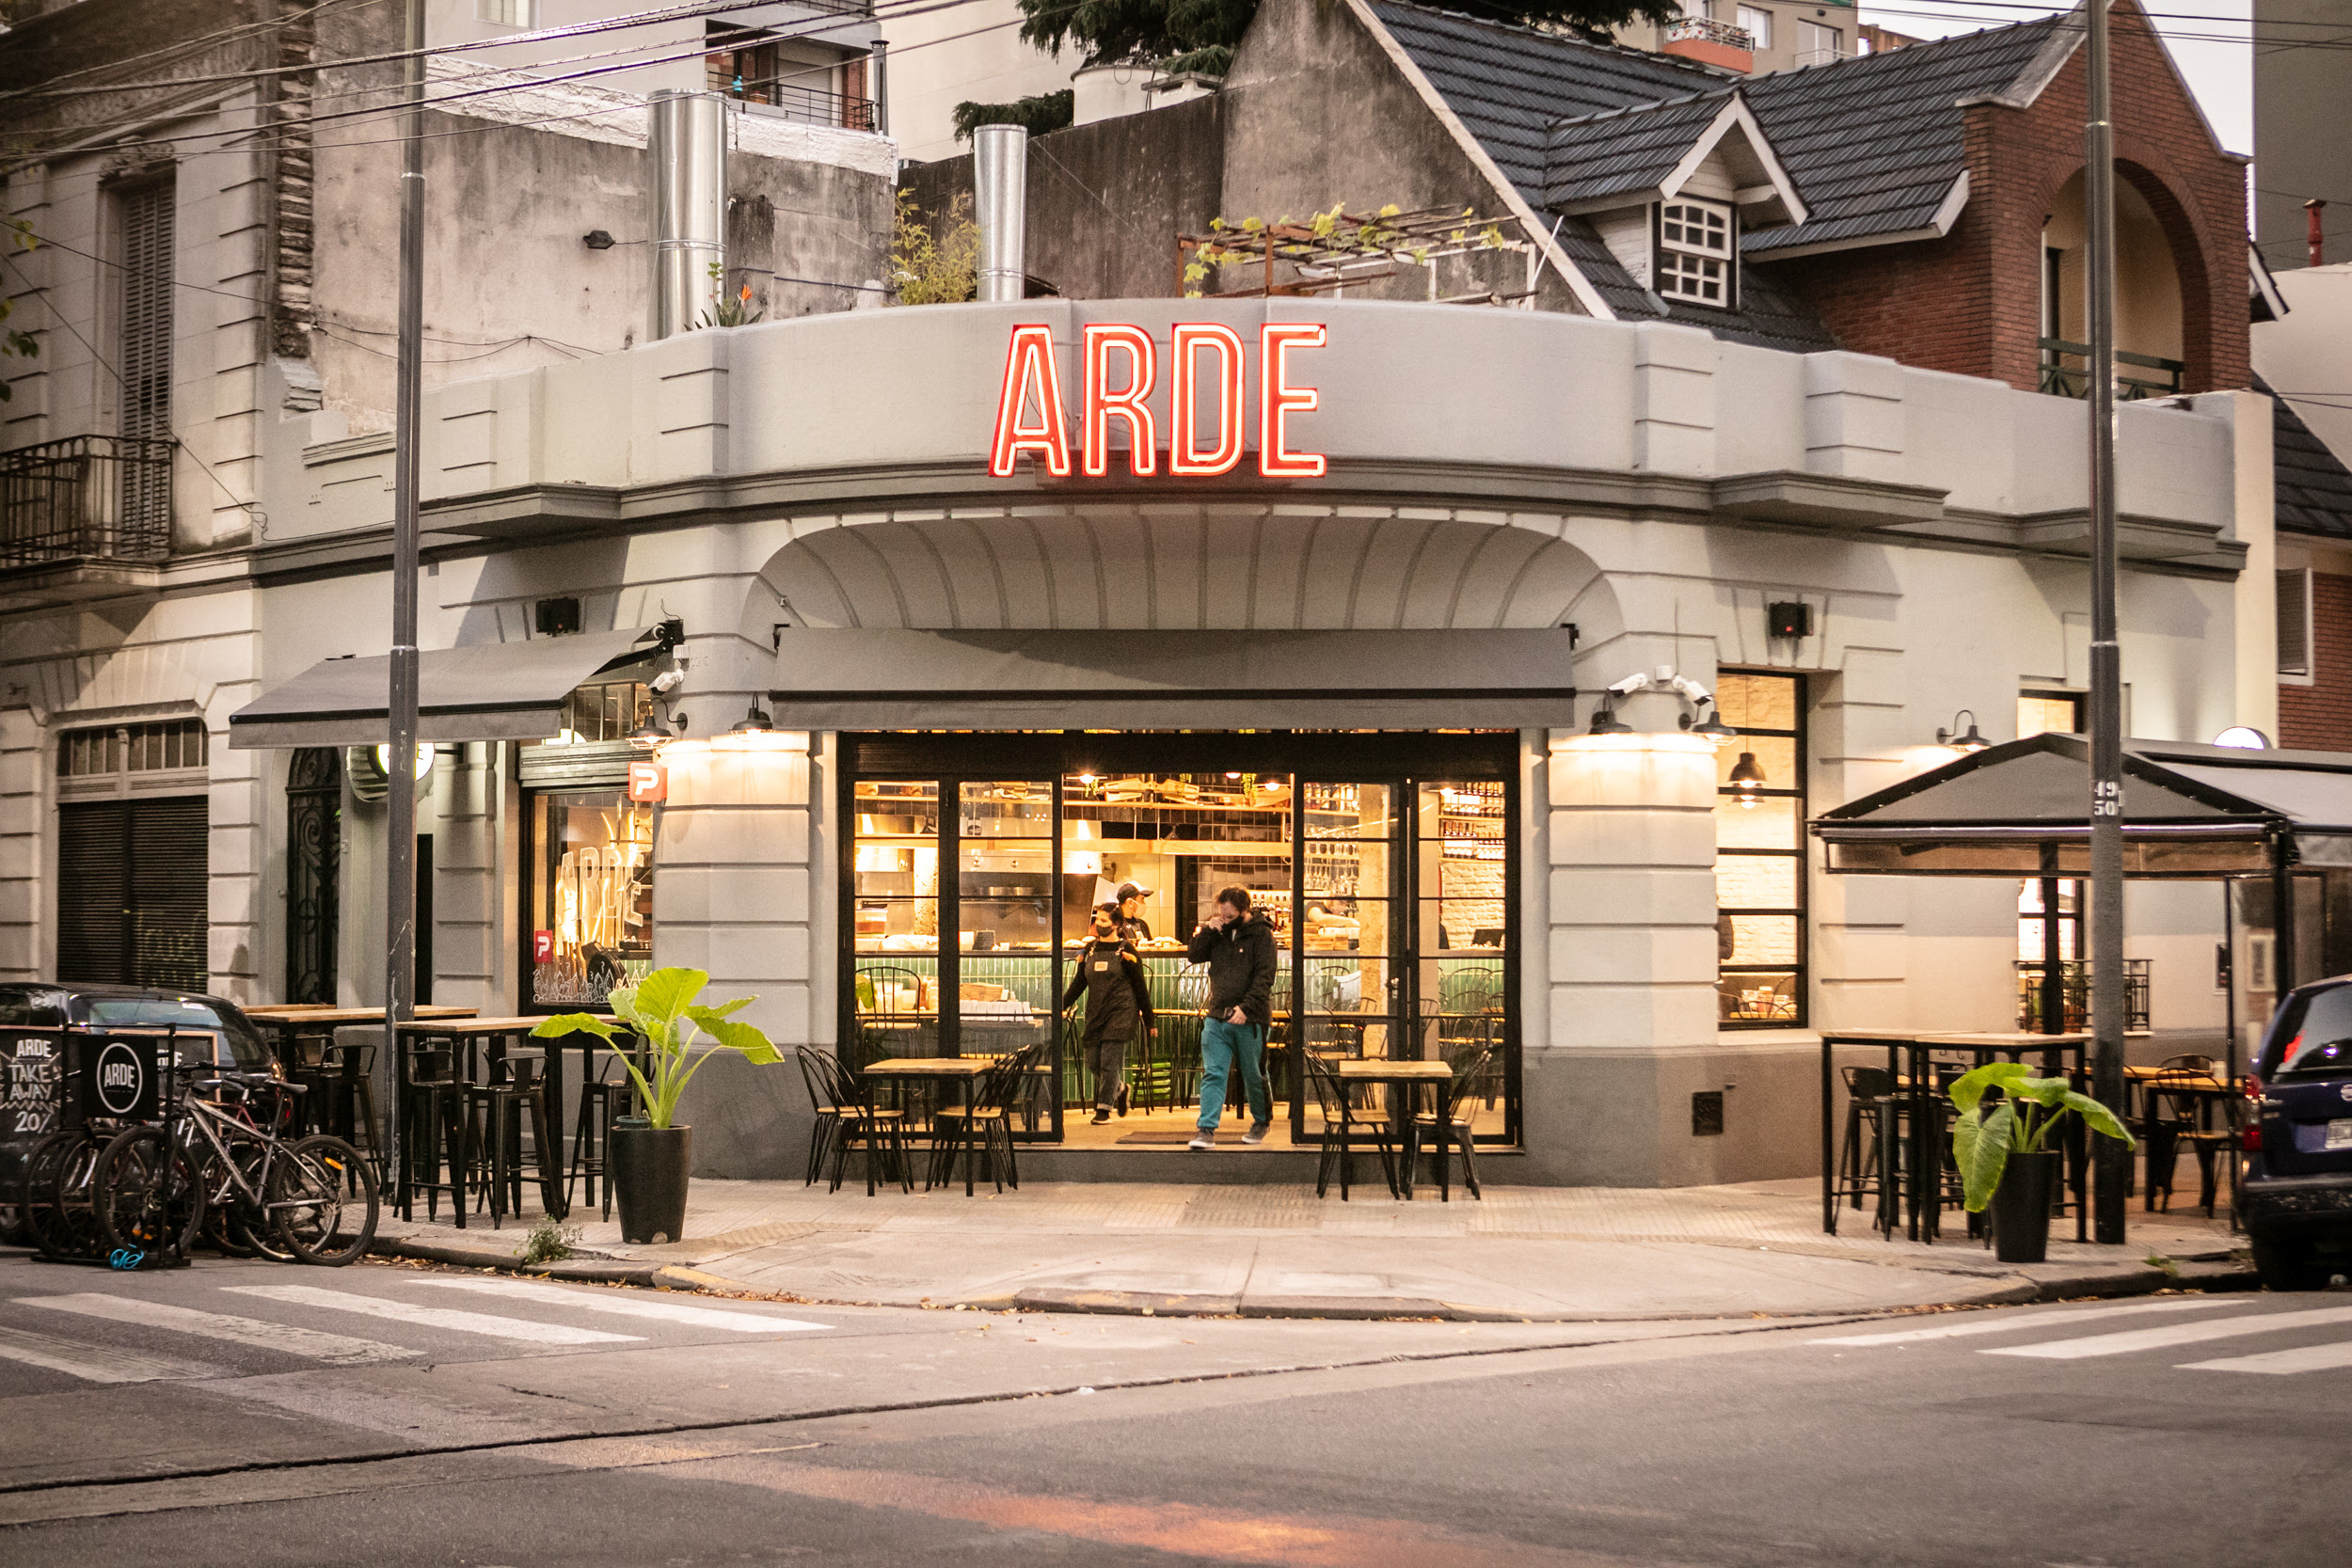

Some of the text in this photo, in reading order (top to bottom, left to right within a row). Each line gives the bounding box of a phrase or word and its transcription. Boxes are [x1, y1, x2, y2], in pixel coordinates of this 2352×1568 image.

[988, 324, 1327, 477] ARDE
[2093, 800, 2120, 816] 50
[555, 846, 644, 927] ARDE
[16, 1038, 53, 1058] ARDE
[8, 1064, 52, 1084] TAKE
[103, 1063, 135, 1088] ARDE
[8, 1083, 53, 1101] AWAY
